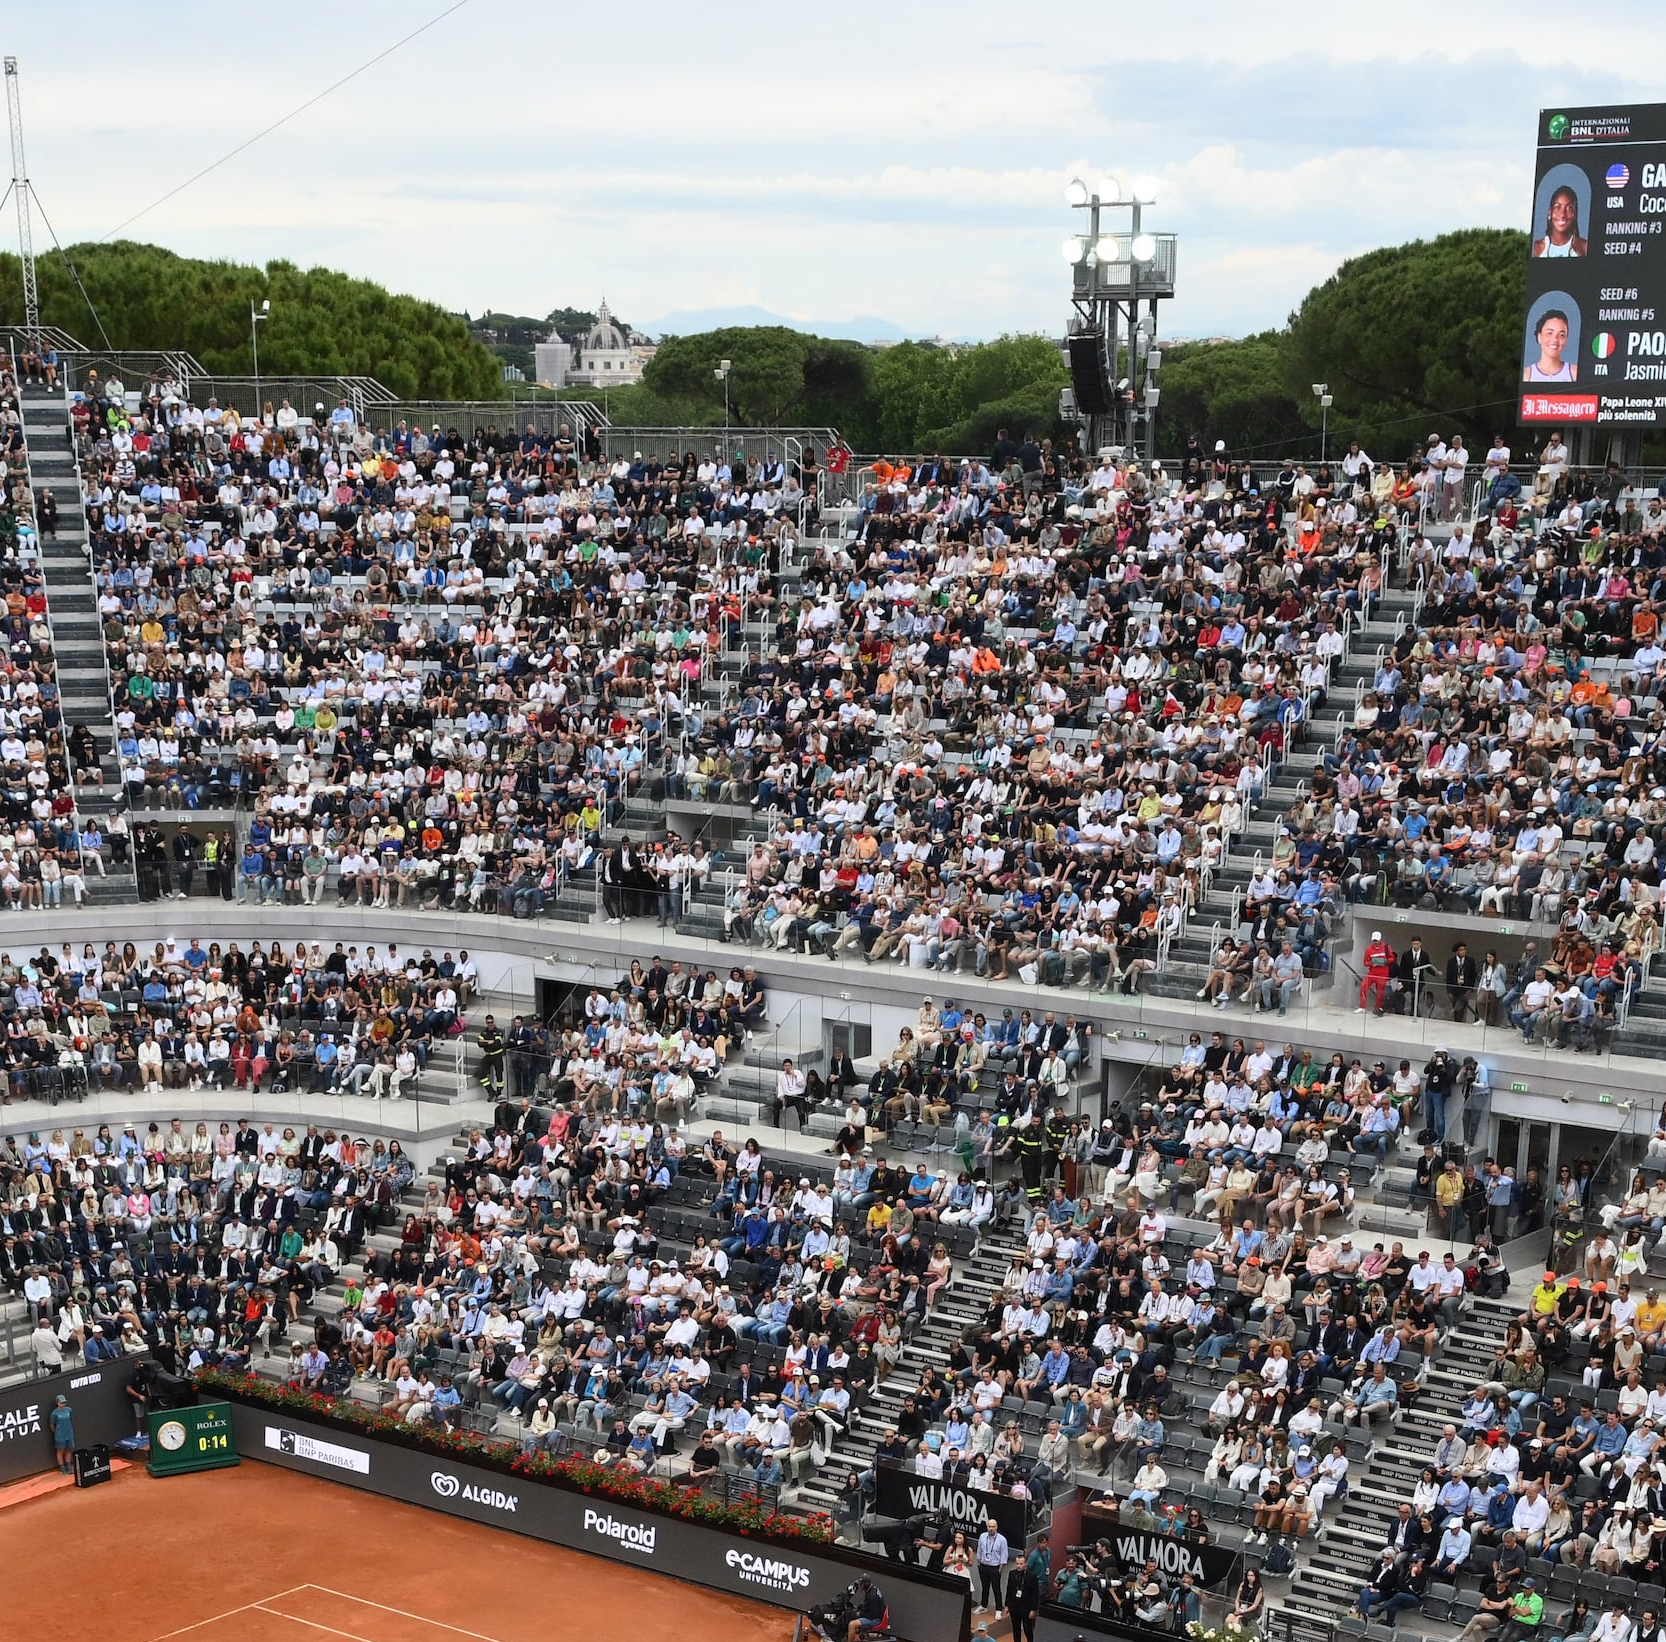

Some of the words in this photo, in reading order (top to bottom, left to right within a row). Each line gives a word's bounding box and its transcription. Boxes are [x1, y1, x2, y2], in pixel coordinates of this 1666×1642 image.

[1571, 117, 1630, 127] INTERNAZIONALI
[1570, 126, 1594, 136] BNL
[1595, 126, 1630, 135] D'ITALIA
[1607, 196, 1624, 209] USA
[1606, 222, 1647, 235] RANKING
[1649, 221, 1662, 234] #3
[1604, 243, 1628, 255] SEED
[1629, 242, 1642, 254] #4
[1599, 288, 1623, 301] SEED
[1624, 287, 1638, 300] #6
[1598, 308, 1640, 321] RANKING
[1641, 308, 1655, 321] #5
[1594, 364, 1608, 376] ITA
[1536, 399, 1596, 418] Messaggero
[1600, 397, 1624, 410] Papa
[1624, 397, 1653, 408] Leone
[1597, 410, 1612, 423] più
[1613, 410, 1657, 422] solennità
[196, 1419, 227, 1430] ROLEX
[198, 1434, 228, 1452] 0:14
[298, 1436, 316, 1448] BNL
[298, 1445, 317, 1457] BNP
[318, 1451, 355, 1469] PARIBAS
[462, 1482, 515, 1513] ALGIDA
[908, 1484, 990, 1525] VALMORA
[583, 1508, 656, 1547] Polaroid
[1362, 1525, 1389, 1537] PARIBAS
[620, 1539, 655, 1555] eyewear
[1116, 1535, 1205, 1581] VALMORA
[1344, 1552, 1372, 1565] PARIBAS
[739, 1569, 794, 1593] UNIVERSITÀ
[1326, 1579, 1354, 1591] PARIBAS
